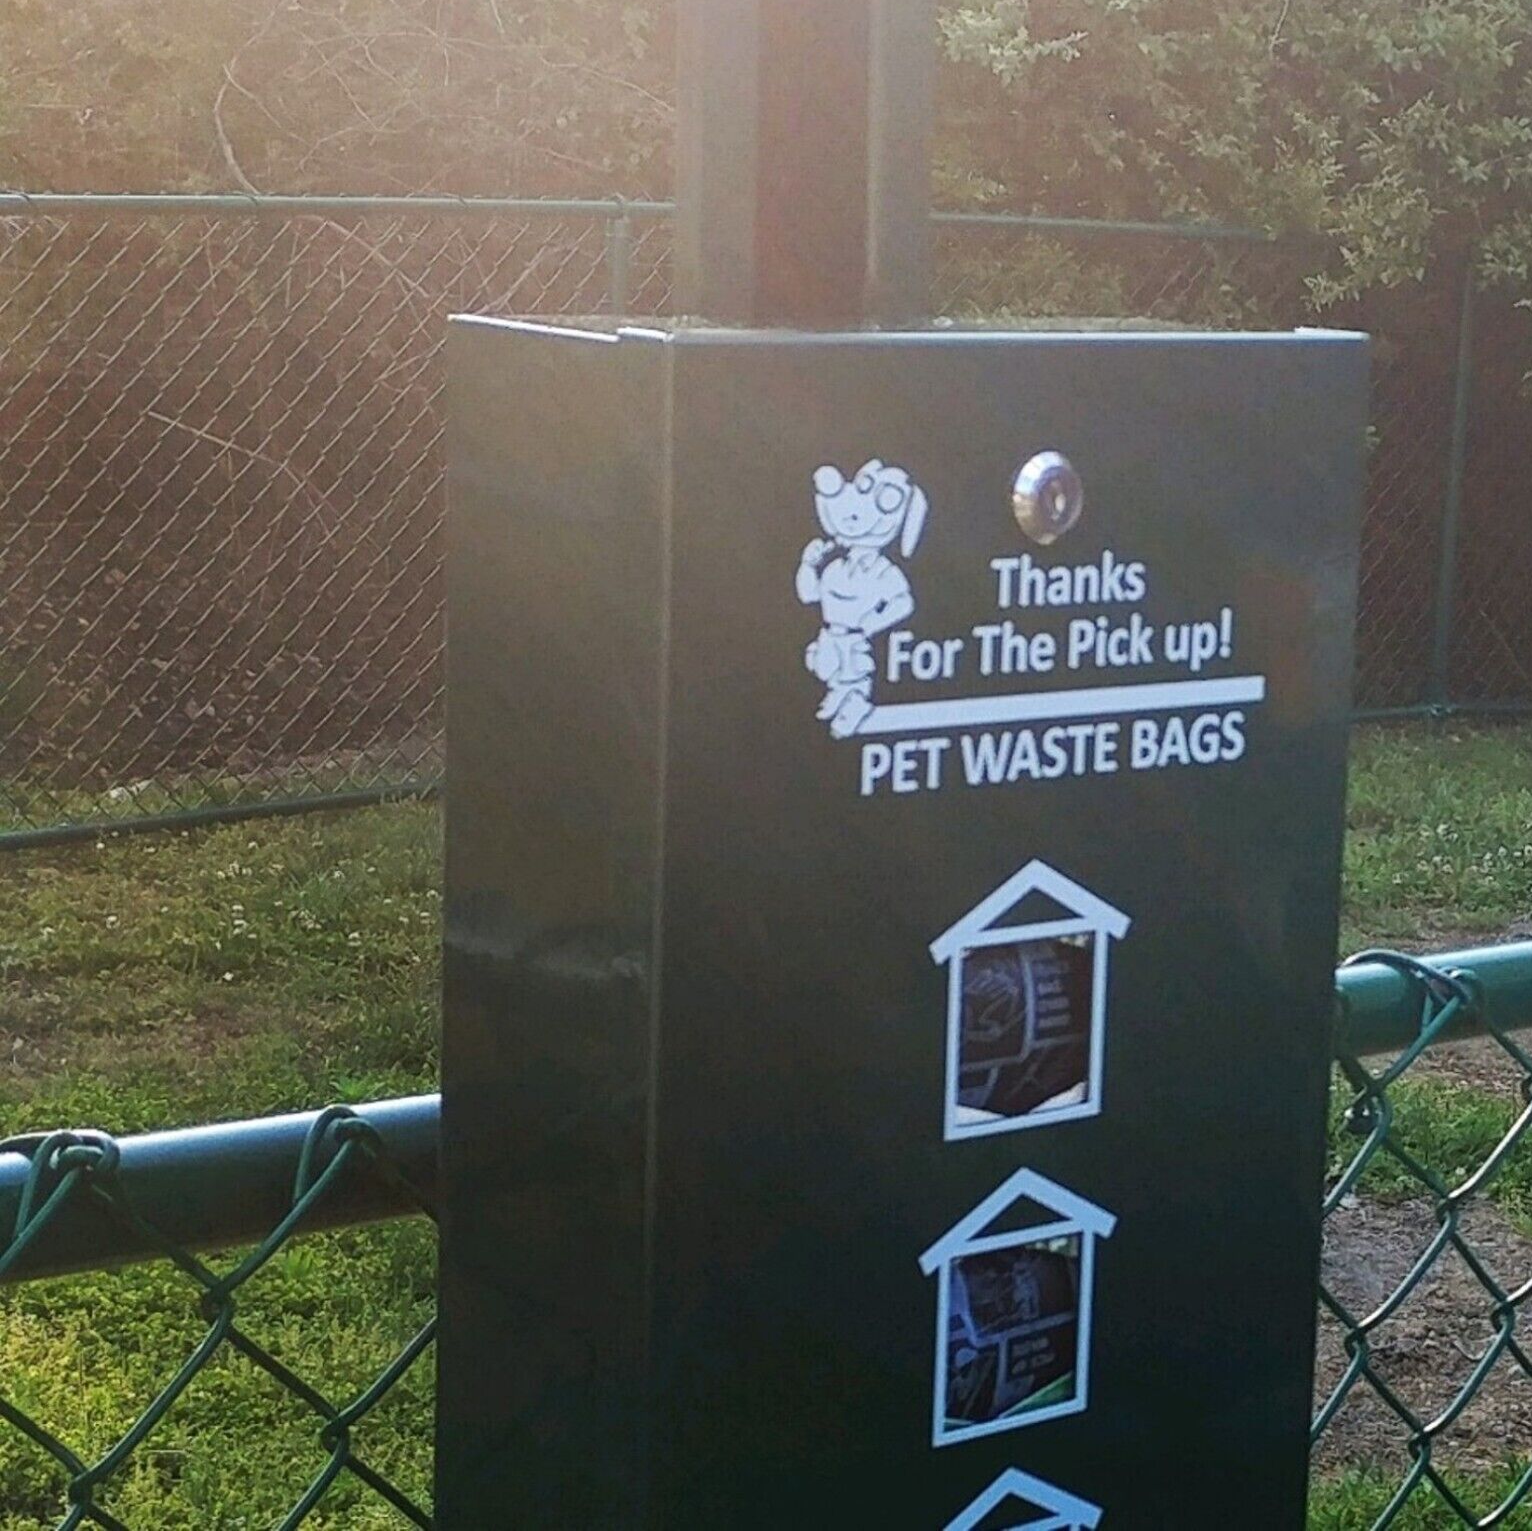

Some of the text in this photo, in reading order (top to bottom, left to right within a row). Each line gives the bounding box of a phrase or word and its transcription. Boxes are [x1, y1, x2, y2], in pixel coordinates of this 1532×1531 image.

[991, 550, 1146, 608] Thanks
[887, 607, 1233, 682] For The Pick up!
[860, 711, 1247, 796] PET WASTE BAGS
